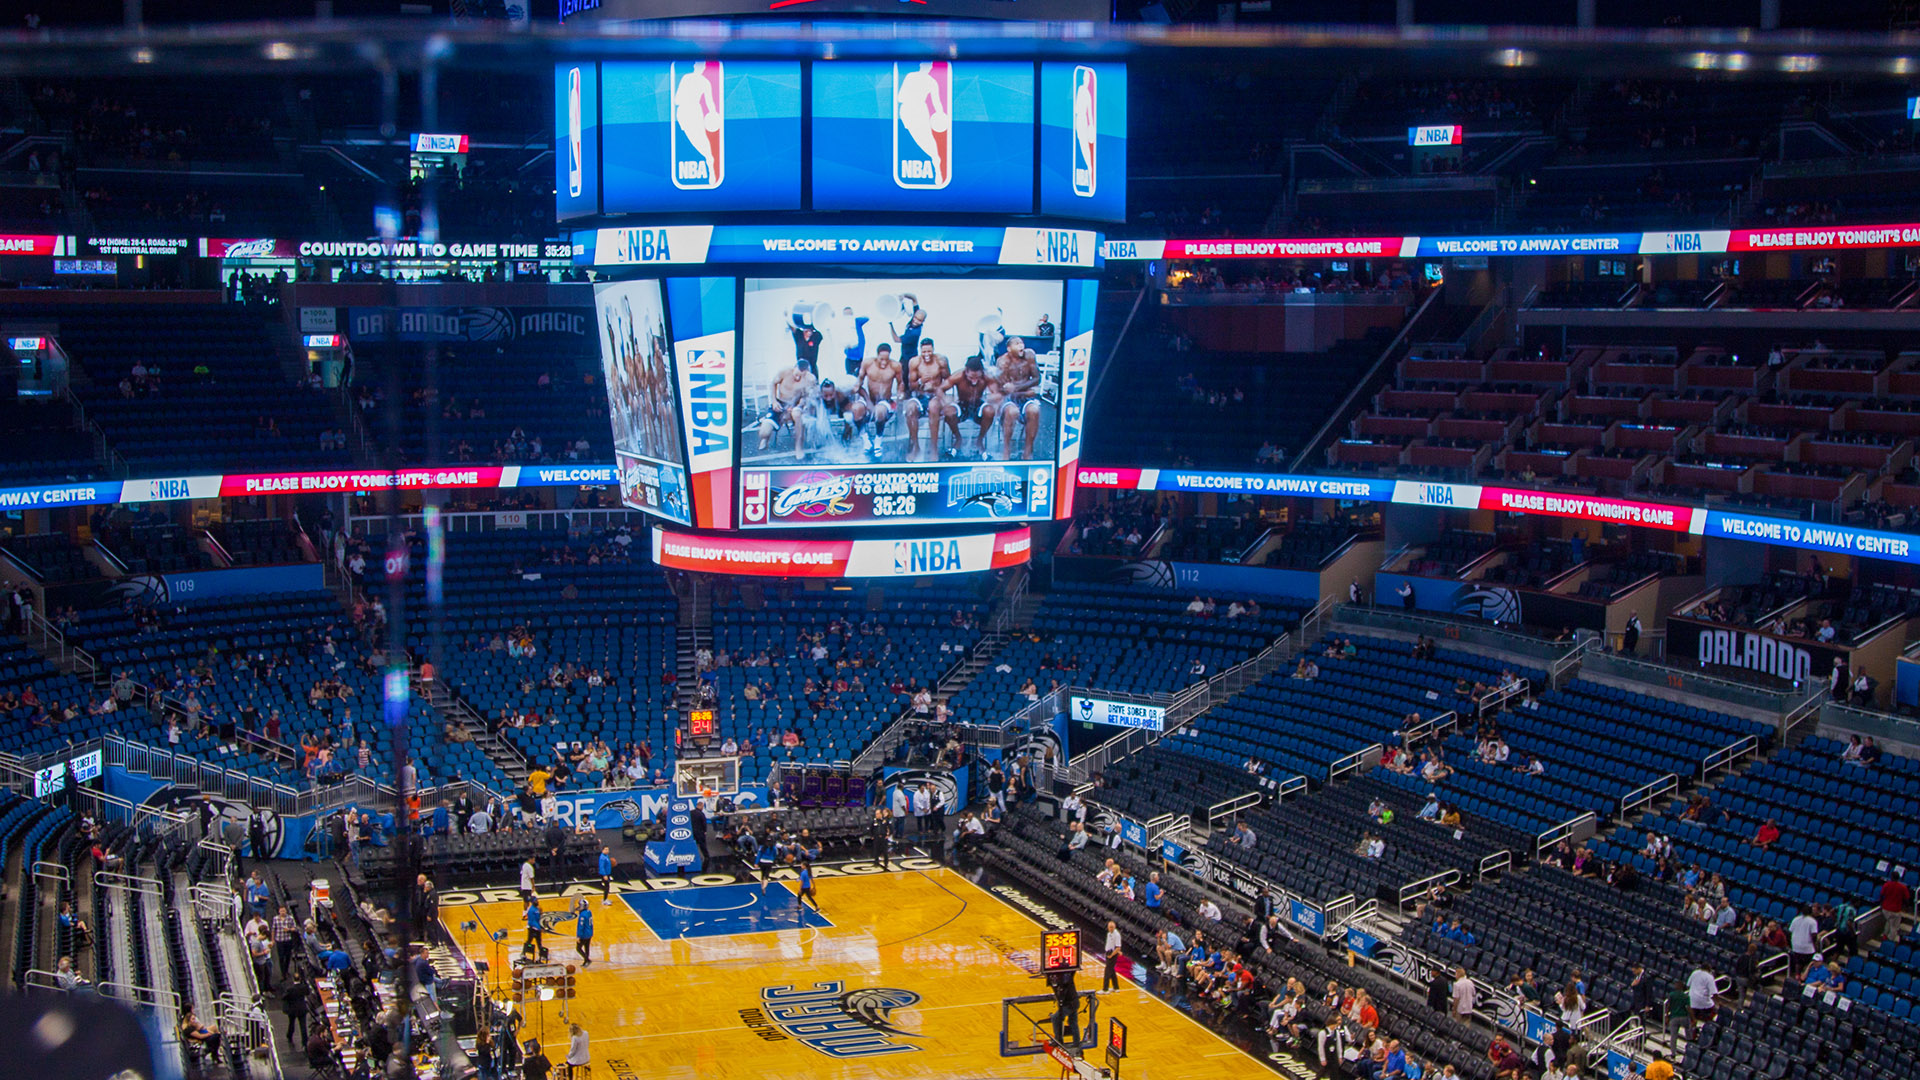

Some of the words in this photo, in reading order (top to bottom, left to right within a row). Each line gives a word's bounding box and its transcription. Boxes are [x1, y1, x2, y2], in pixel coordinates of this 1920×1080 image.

[431, 136, 456, 150] NBA
[1426, 129, 1449, 142] NBA
[678, 160, 708, 179] NBA
[901, 160, 934, 179] NBA
[628, 229, 671, 262] NBA
[763, 239, 837, 251] WELCOME
[839, 239, 860, 251] TO
[863, 239, 919, 252] AMWAY
[922, 239, 974, 252] CENTER
[1047, 231, 1079, 263] NBA
[1437, 240, 1498, 253] WELCOME
[1500, 240, 1517, 252] TO
[1520, 240, 1569, 252] AMWAY
[1572, 238, 1619, 251] CENTER
[1674, 233, 1702, 251] NBA
[1749, 233, 1794, 248] PLEASE
[1795, 232, 1836, 246] ENJOY
[1838, 229, 1900, 245] TONIGHT'S
[99, 246, 111, 254] 1ST
[111, 246, 120, 254] IN
[120, 246, 149, 254] CENTRAL
[149, 247, 177, 255] DIVISION
[299, 242, 416, 257] COUNTDOWN
[418, 243, 447, 257] TO
[449, 243, 497, 257] GAME
[499, 243, 539, 257] TIME
[545, 245, 572, 257] 35:26
[1109, 241, 1137, 258] NBA
[1185, 242, 1232, 256] PLEASE
[1233, 242, 1277, 255] ENJOY
[1278, 241, 1344, 255] TONIGHT'S
[1346, 241, 1382, 254] GAME
[357, 312, 459, 335] ORANDO
[521, 311, 585, 336] MAGIC
[315, 337, 331, 345] NBA
[688, 373, 729, 456] NBA
[1062, 370, 1084, 450] NBA
[246, 478, 300, 492] PLEASE
[301, 476, 348, 490] ENJOY
[436, 472, 478, 485] GAME
[539, 470, 611, 482] WELCOME
[854, 472, 940, 485] COUNTDOWN
[1078, 472, 1118, 485] GAME
[158, 480, 190, 499] NBA
[854, 484, 872, 495] TO
[873, 483, 909, 494] GAME
[910, 482, 940, 493] TIME
[947, 471, 1024, 508] MAGIC
[1031, 468, 1049, 512] ORL
[1177, 474, 1243, 490] WELCOME
[1245, 477, 1263, 490] TO
[1266, 478, 1318, 493] AMWAY
[1319, 482, 1370, 497] CENTER
[43, 488, 95, 503] CENTER
[745, 473, 766, 522] CLE
[1426, 486, 1454, 505] NBA
[872, 494, 916, 516] 35:26
[1501, 493, 1544, 511] PLEASE
[1545, 497, 1584, 515] ENJOY
[1586, 501, 1641, 521] TONIGHT'S
[1642, 508, 1674, 526] GAME
[501, 514, 520, 524] 110
[1722, 517, 1781, 540] WELCOME
[1783, 525, 1801, 541] TO
[1802, 528, 1854, 549] AMWAY
[1856, 534, 1909, 556] CENTER
[664, 543, 691, 559] PLEASE
[691, 546, 724, 561] ENJOY
[724, 549, 791, 564] TONIGHT'S
[792, 552, 834, 565] GAME
[910, 540, 962, 573] NBA
[1181, 568, 1200, 582] 112
[175, 579, 195, 593] 109
[1698, 630, 1811, 682] ORLANDO
[691, 710, 713, 722] 35:26
[1108, 703, 1125, 715] DRIVE
[1127, 706, 1147, 717] SOBER
[1108, 714, 1119, 724] GET
[692, 720, 712, 735] 24
[667, 851, 695, 865] Amway
[749, 858, 941, 881] MAGIC
[1213, 867, 1230, 886] PURE
[1235, 878, 1259, 899] MAGIC
[1297, 913, 1316, 929] MAGIC
[1303, 908, 1316, 919] PURE
[1045, 932, 1077, 947] 35:26
[1049, 946, 1073, 967] 24
[1420, 966, 1435, 983] PU
[737, 1008, 789, 1042] ORLANDO
[758, 980, 925, 1060] MAGIC
[1268, 1053, 1319, 1080] Orlan
